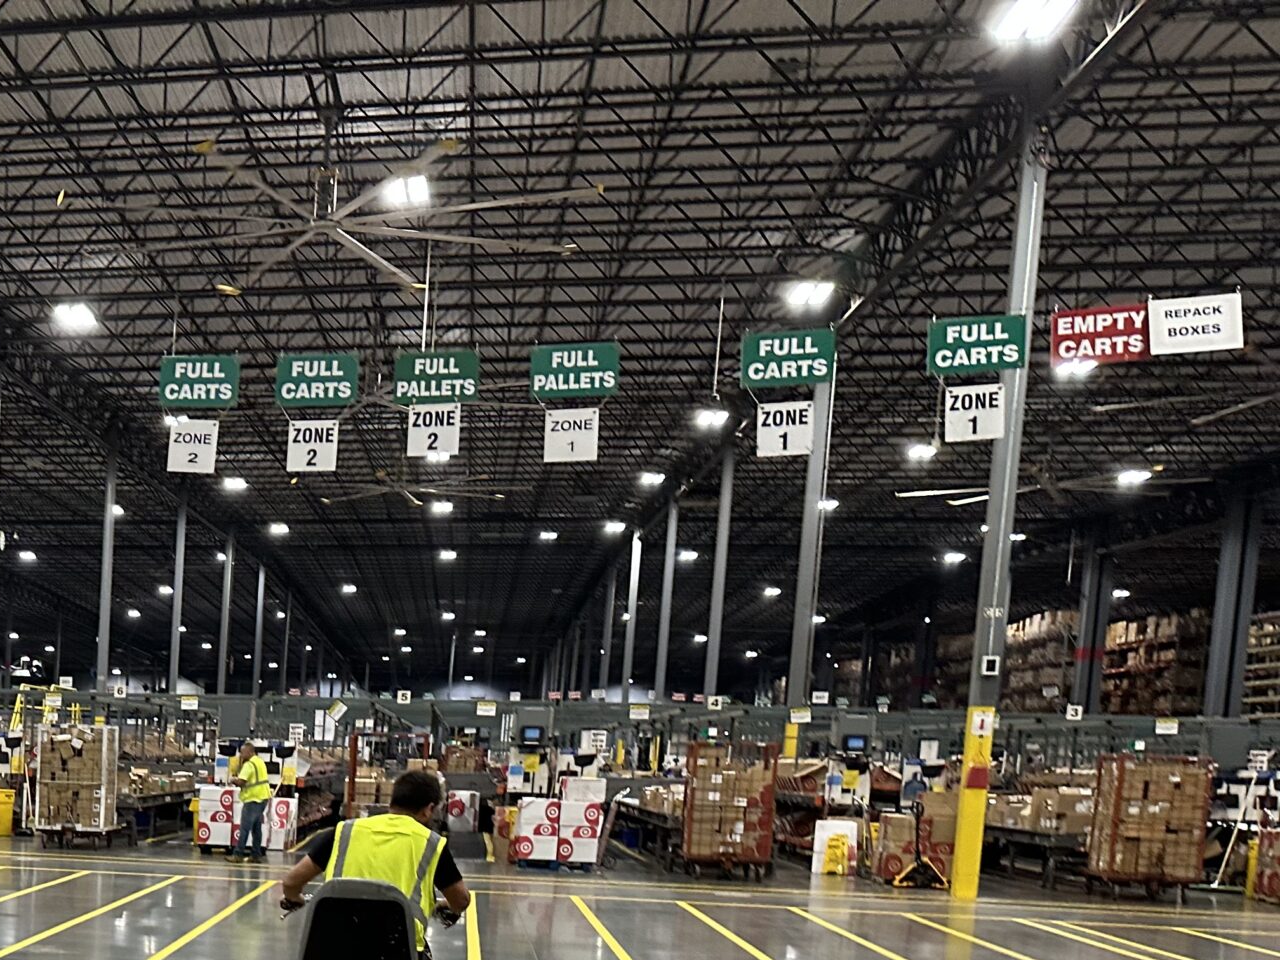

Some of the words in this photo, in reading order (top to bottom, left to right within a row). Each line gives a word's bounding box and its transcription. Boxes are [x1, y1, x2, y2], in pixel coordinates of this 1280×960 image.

[1164, 305, 1222, 319] REPACK
[1057, 310, 1146, 335] EMPTY
[1168, 323, 1221, 337] BOXES
[946, 321, 1009, 344] FULL
[759, 336, 819, 357] FULL
[1058, 334, 1144, 358] CARTS
[551, 349, 599, 368] FULL
[934, 344, 1019, 368] CARTS
[174, 362, 225, 379] FULL
[291, 360, 344, 377] FULL
[414, 357, 460, 375] FULL
[747, 358, 828, 380] CARTS
[396, 378, 476, 397] PALLETS
[533, 370, 616, 391] PALLETS
[164, 383, 233, 400] CARTS
[280, 381, 352, 399] CARTS
[949, 391, 999, 412] ZONE
[412, 410, 456, 428] ZONE
[550, 418, 594, 432] ZONE
[761, 408, 809, 427] ZONE
[968, 415, 978, 435] 1
[173, 432, 212, 445] ZONE
[292, 427, 335, 444] ZONE
[427, 432, 439, 450] 2
[779, 431, 788, 451] 1
[567, 441, 575, 452] 1
[187, 452, 198, 464] 2
[306, 448, 318, 467] 2
[117, 687, 123, 696] 6
[401, 692, 408, 702] 5
[711, 698, 719, 707] 4
[1070, 708, 1078, 717] 3
